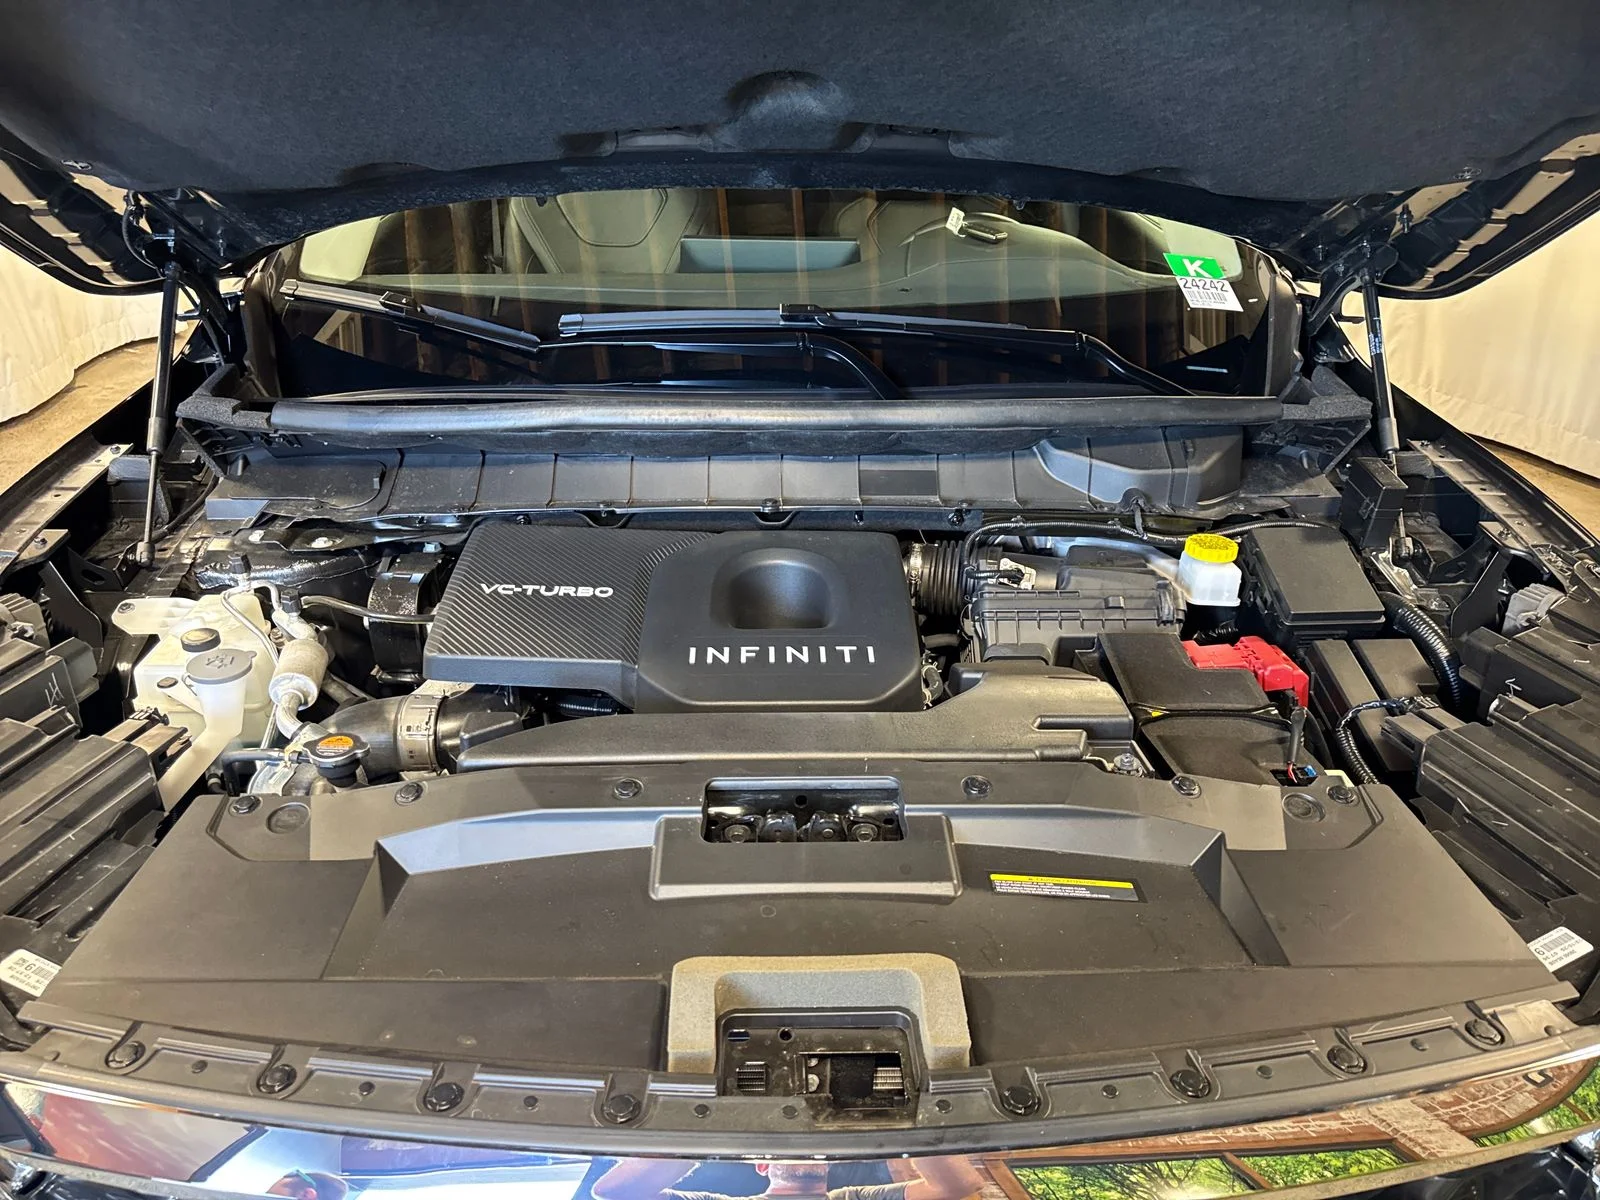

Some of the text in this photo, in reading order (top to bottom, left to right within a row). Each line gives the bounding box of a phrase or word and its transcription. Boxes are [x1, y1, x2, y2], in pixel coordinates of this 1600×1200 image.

[1181, 258, 1213, 278] K
[1179, 278, 1229, 292] 24242
[480, 583, 614, 598] VC-TURBO
[688, 645, 876, 665] INFINITI
